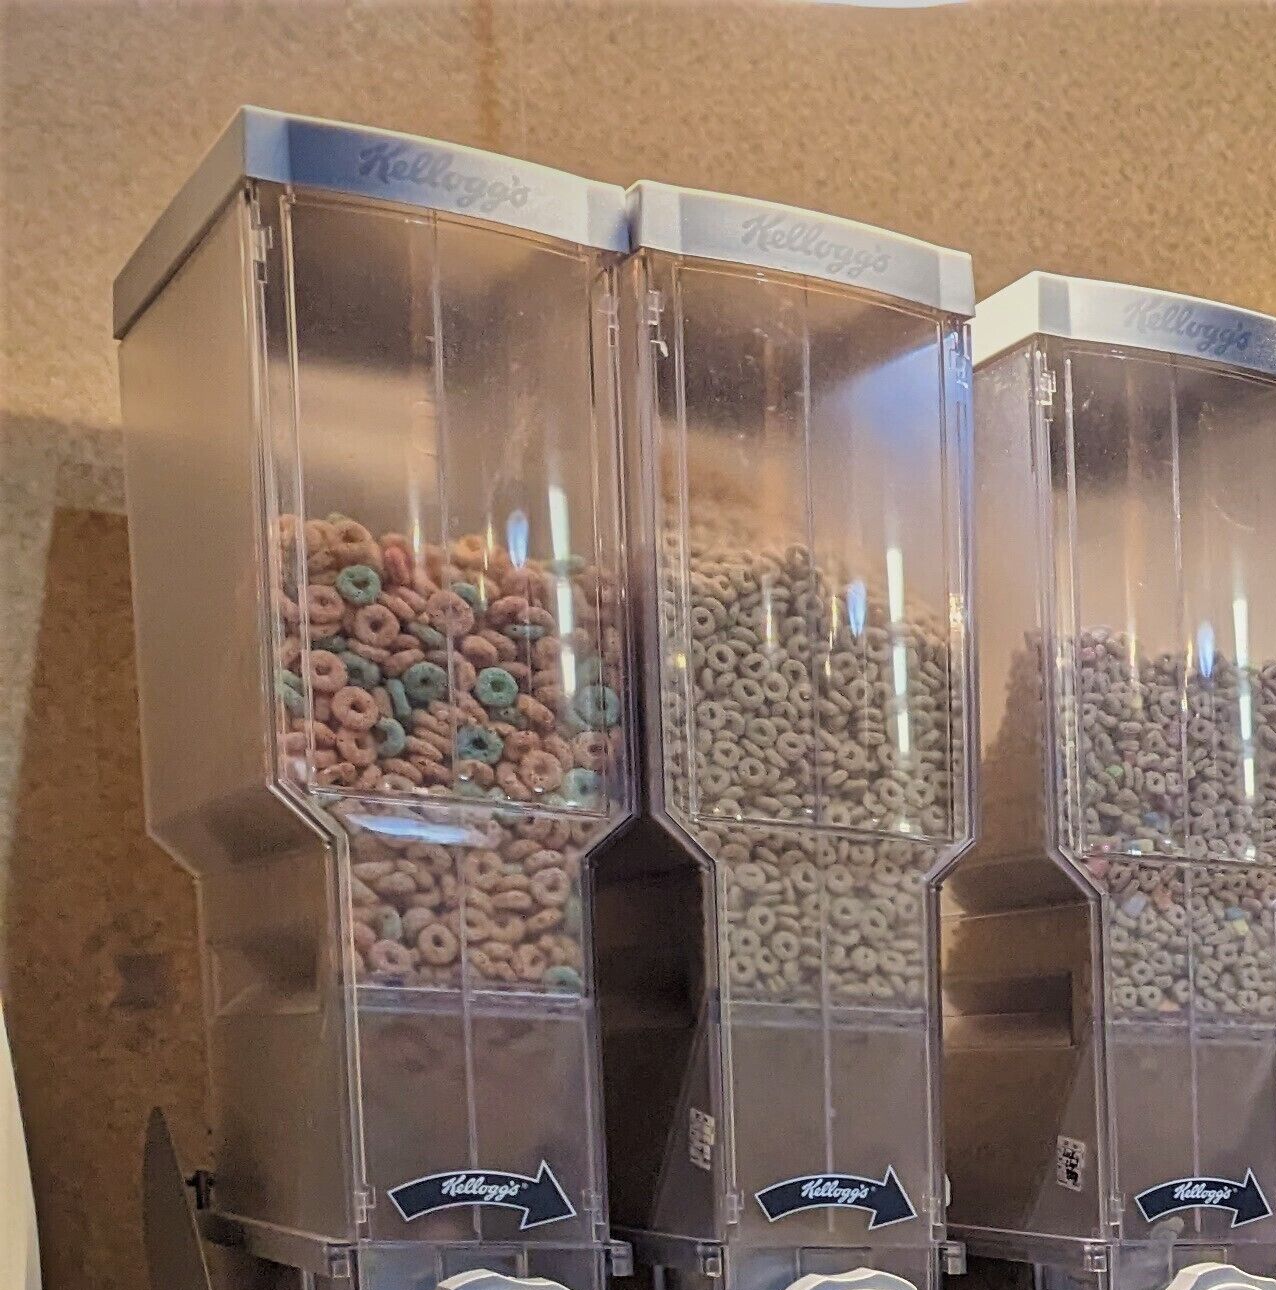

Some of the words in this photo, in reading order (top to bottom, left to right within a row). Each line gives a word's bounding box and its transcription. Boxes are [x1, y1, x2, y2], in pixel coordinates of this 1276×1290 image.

[358, 142, 531, 213] Kellogg's
[741, 203, 890, 278] Kellogg's
[1123, 302, 1251, 356] Kellogg's
[441, 1174, 521, 1201] Kellogg's
[801, 1178, 869, 1203] Kellogg's
[1173, 1181, 1232, 1204] Kellogg's
